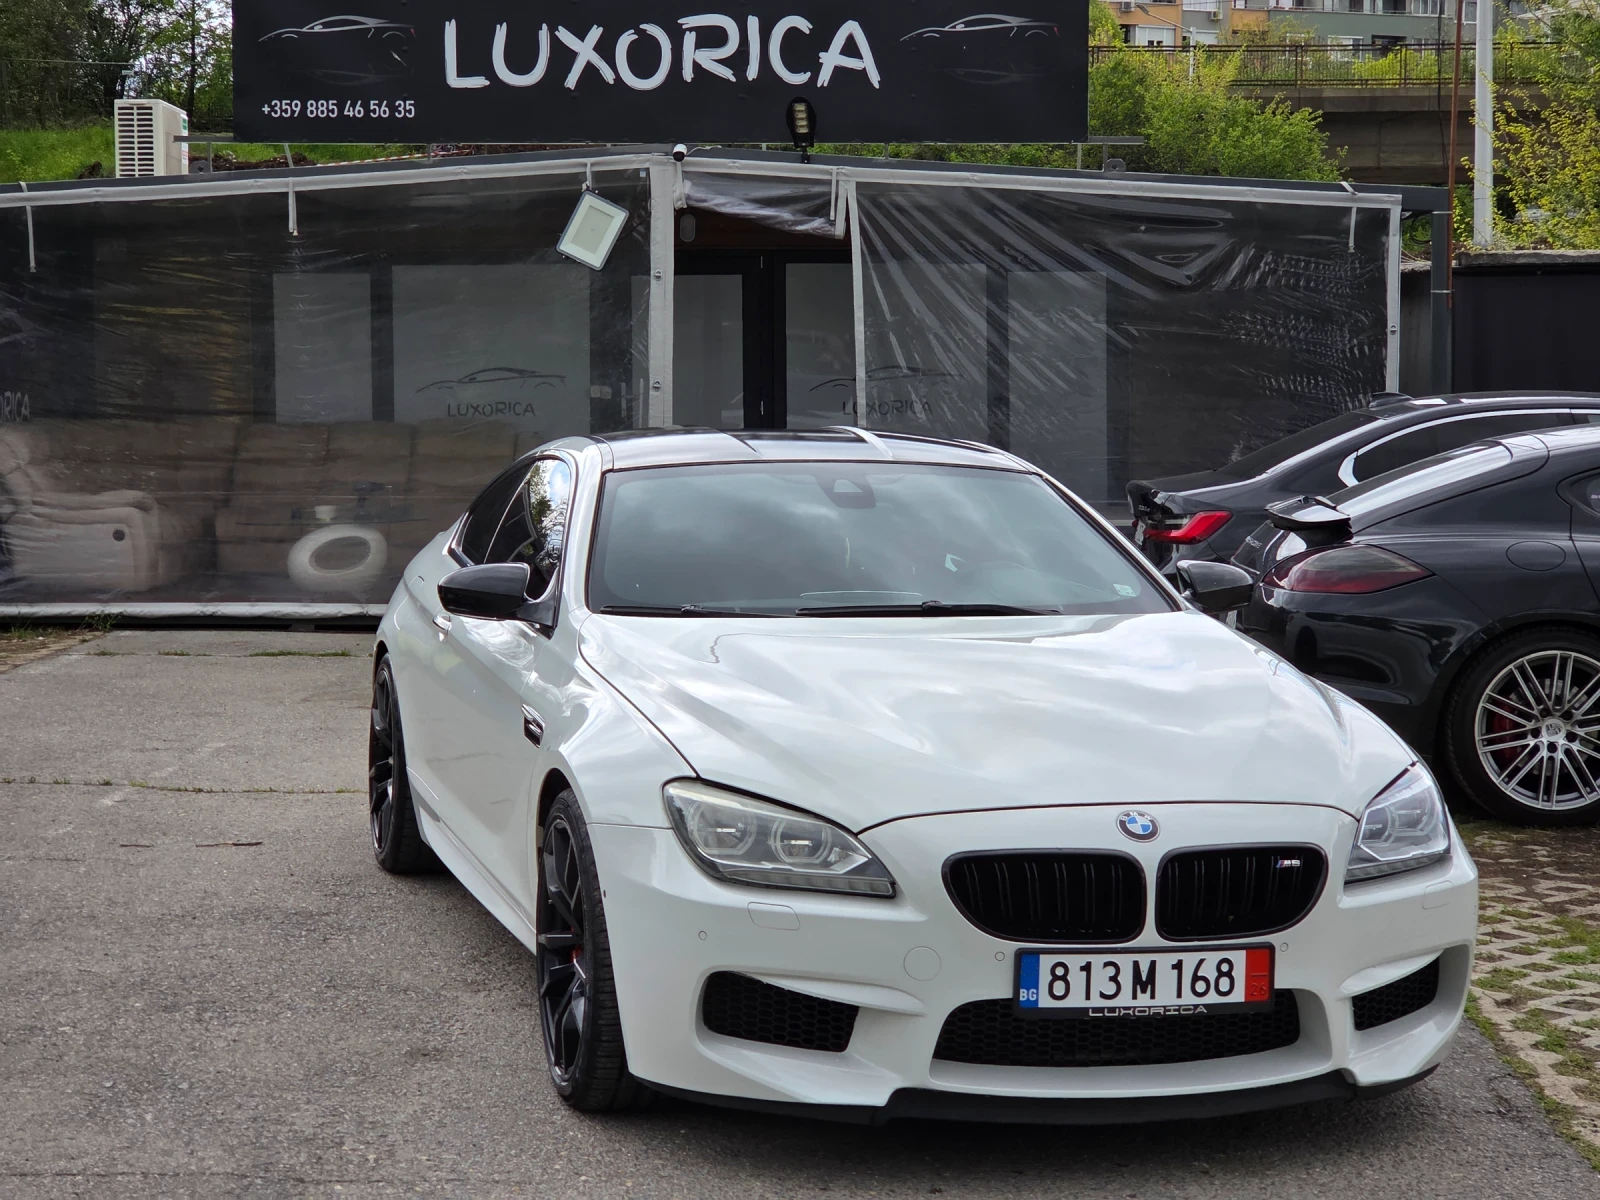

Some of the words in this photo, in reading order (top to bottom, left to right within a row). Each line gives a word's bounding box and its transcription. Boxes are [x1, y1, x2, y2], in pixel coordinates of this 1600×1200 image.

[444, 13, 881, 91] LUXORICA
[261, 99, 302, 118] +359
[306, 99, 338, 118] 885
[343, 99, 364, 118] 46
[369, 99, 390, 118] 56
[394, 99, 415, 118] 35
[447, 401, 536, 418] LUXORICA
[1047, 960, 1122, 1002] 813
[1131, 959, 1157, 1001] M
[1170, 957, 1236, 1000] 168
[1019, 988, 1038, 1002] BG
[1249, 982, 1267, 997] 26
[1088, 1004, 1208, 1017] LUXORICA
